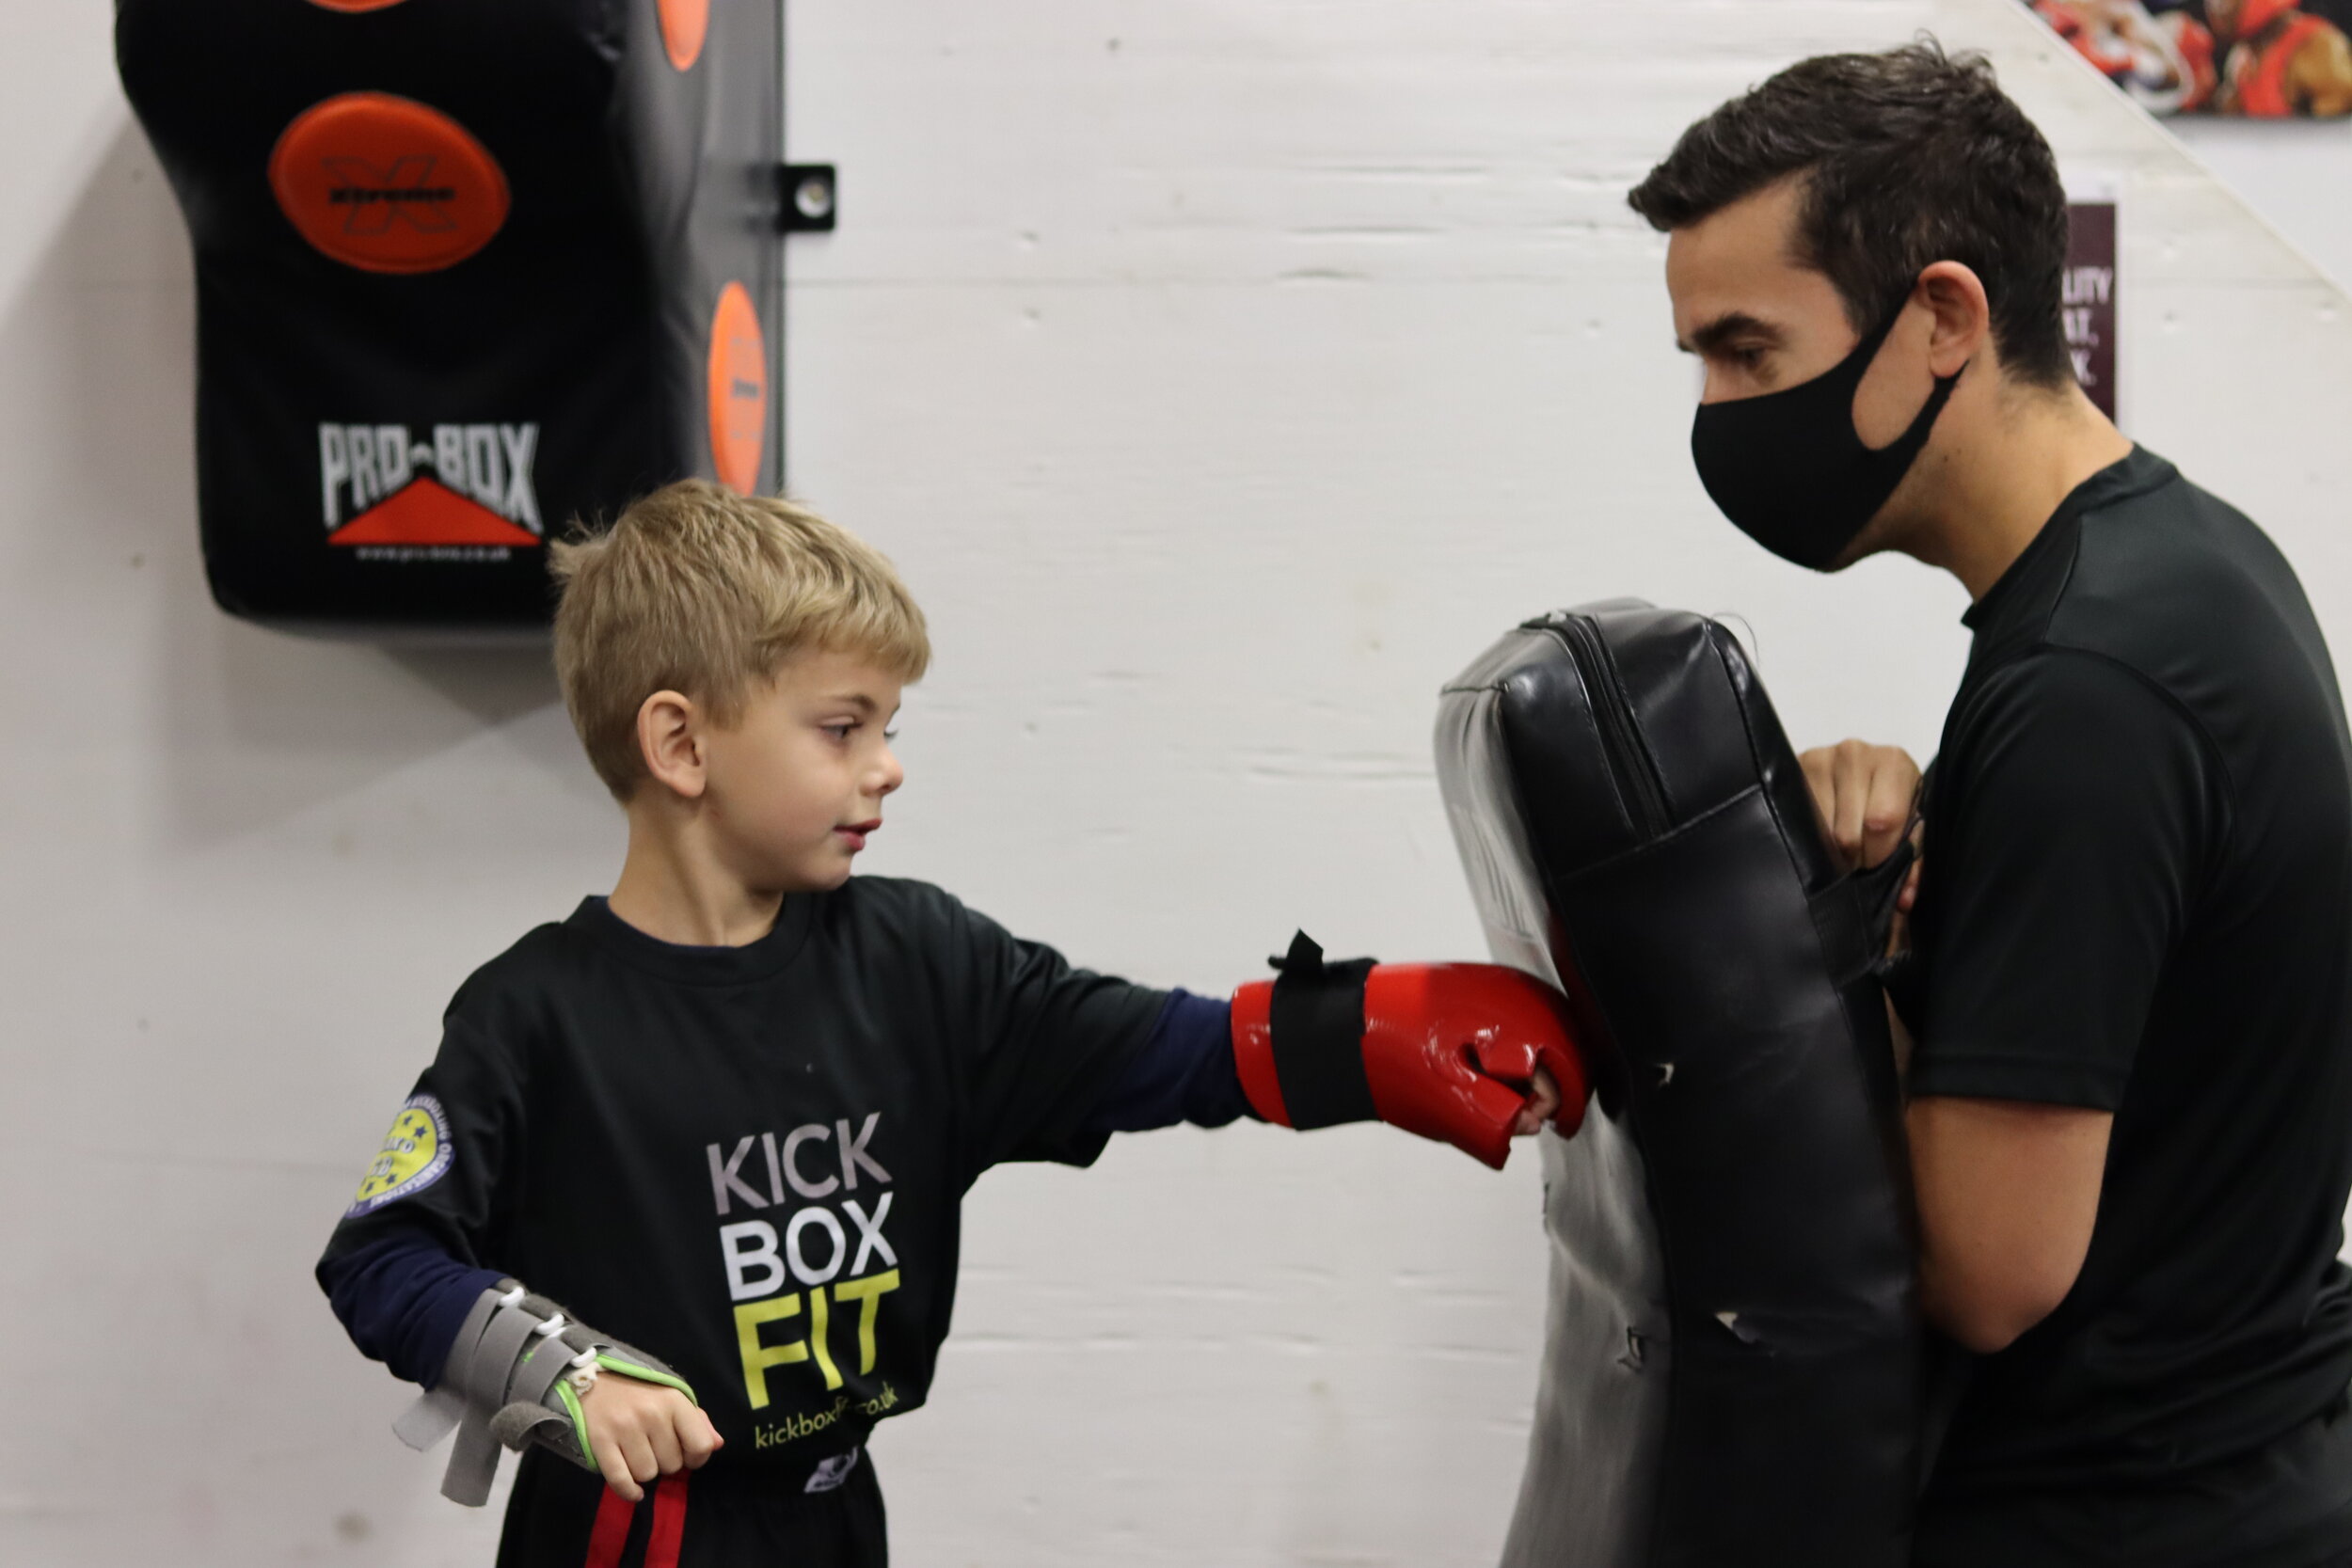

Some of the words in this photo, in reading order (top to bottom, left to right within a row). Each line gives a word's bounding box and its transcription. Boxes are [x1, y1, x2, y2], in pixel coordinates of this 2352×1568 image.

[2062, 266, 2113, 304] LITY
[707, 1112, 893, 1215] KICK
[720, 1192, 898, 1301] BOX
[734, 1268, 900, 1410] FIT
